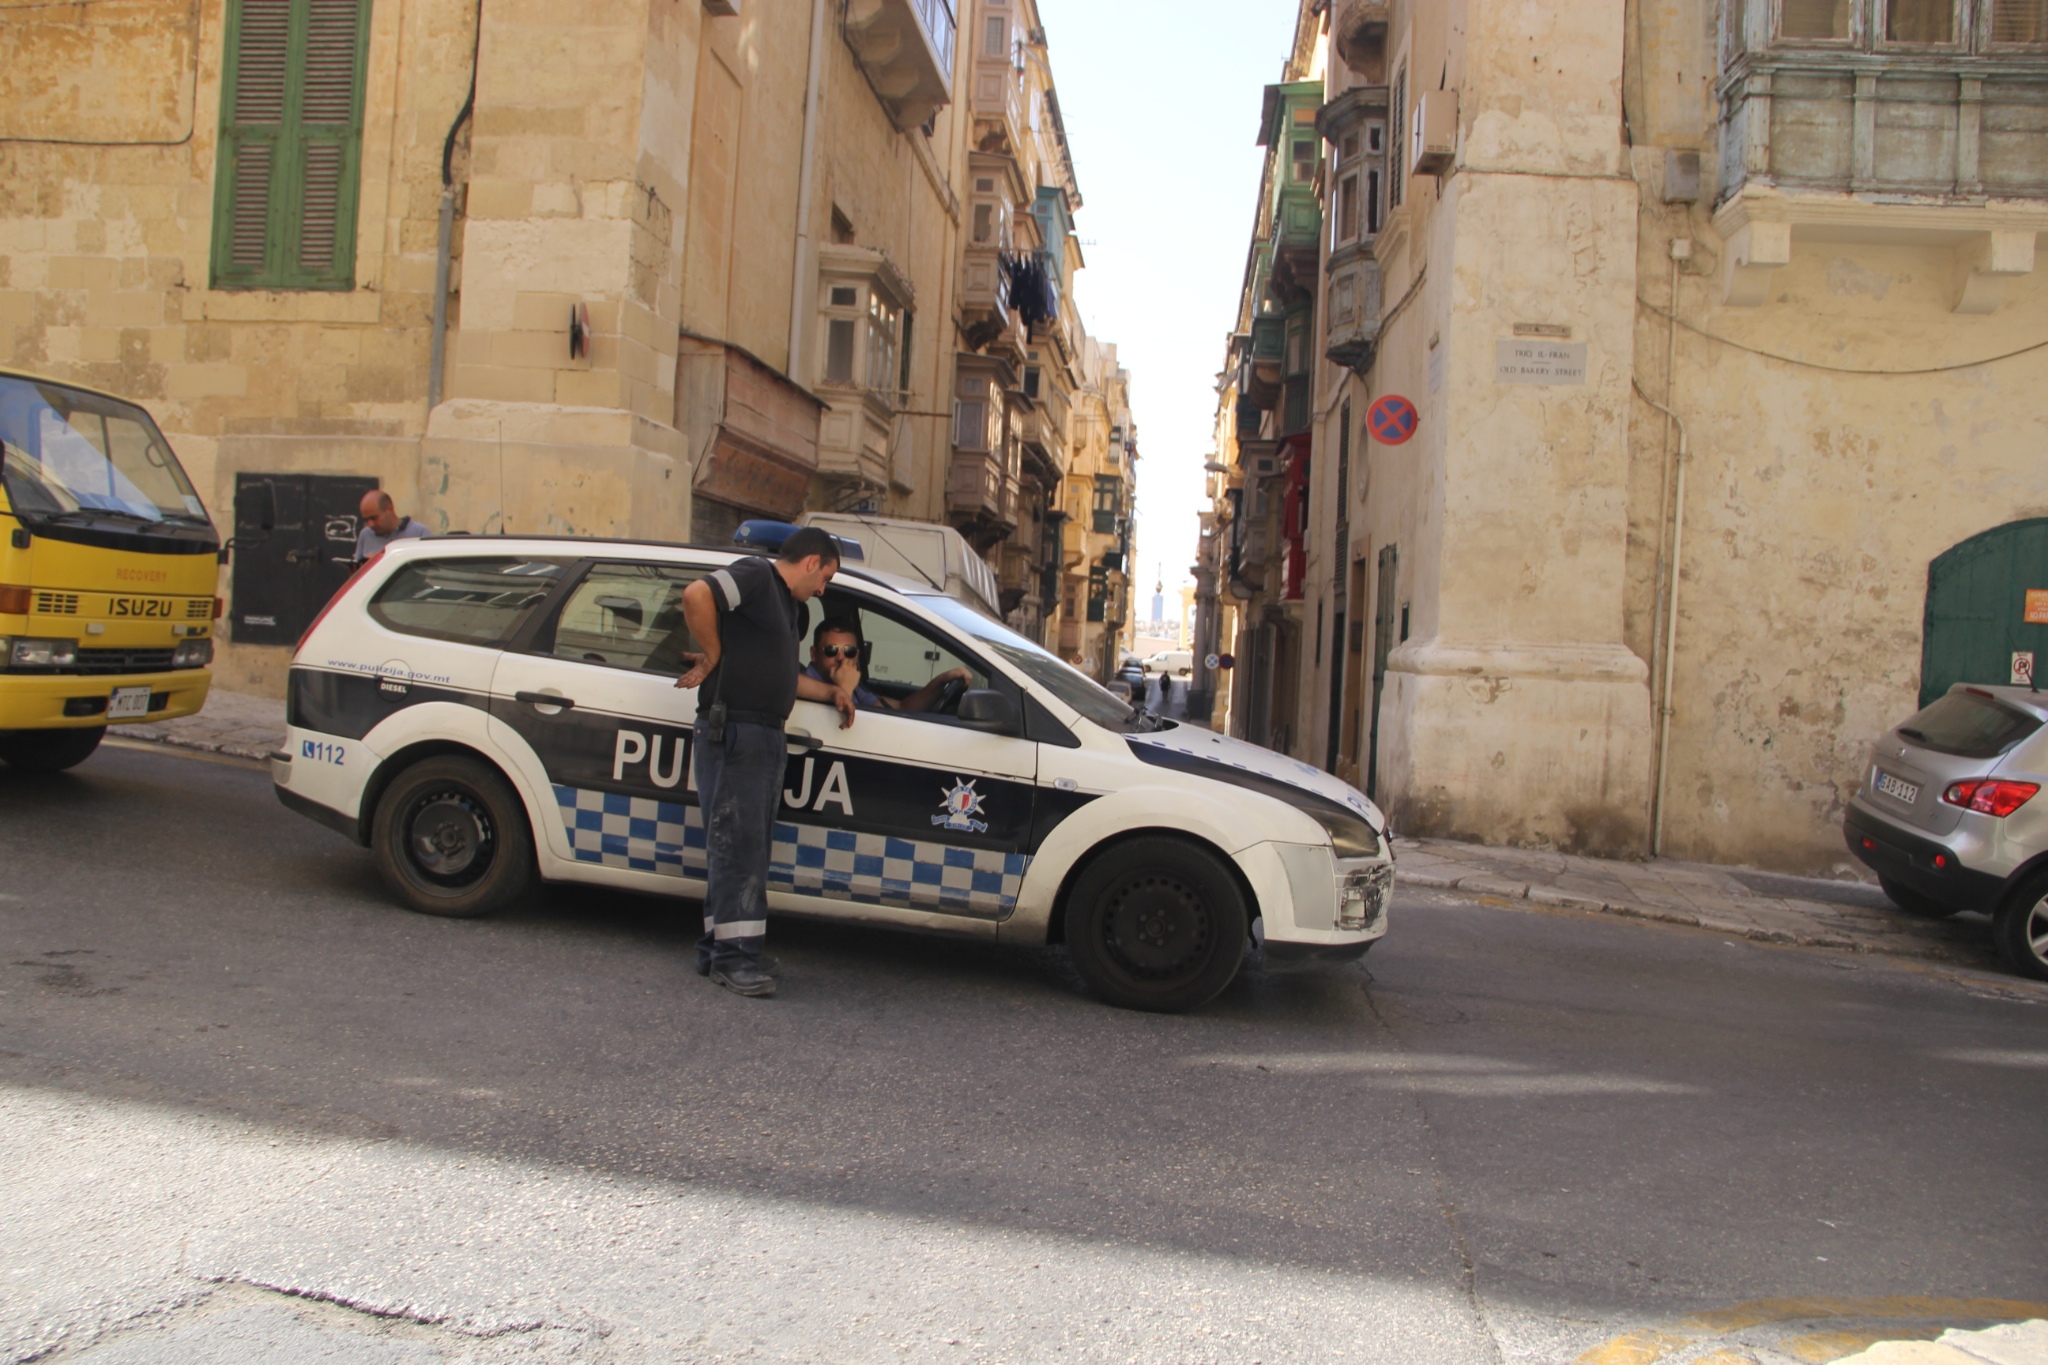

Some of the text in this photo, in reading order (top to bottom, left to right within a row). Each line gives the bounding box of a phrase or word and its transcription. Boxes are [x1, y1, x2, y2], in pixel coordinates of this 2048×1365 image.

[1500, 365, 1582, 377] OLD BAKERY STREET
[116, 568, 168, 583] RECOVERY
[109, 598, 172, 617] ISUZU
[328, 659, 451, 683] www.pulizija.gov.mt
[380, 682, 408, 694] DIESEL
[316, 741, 345, 766] 112
[1898, 782, 1916, 802] 112
